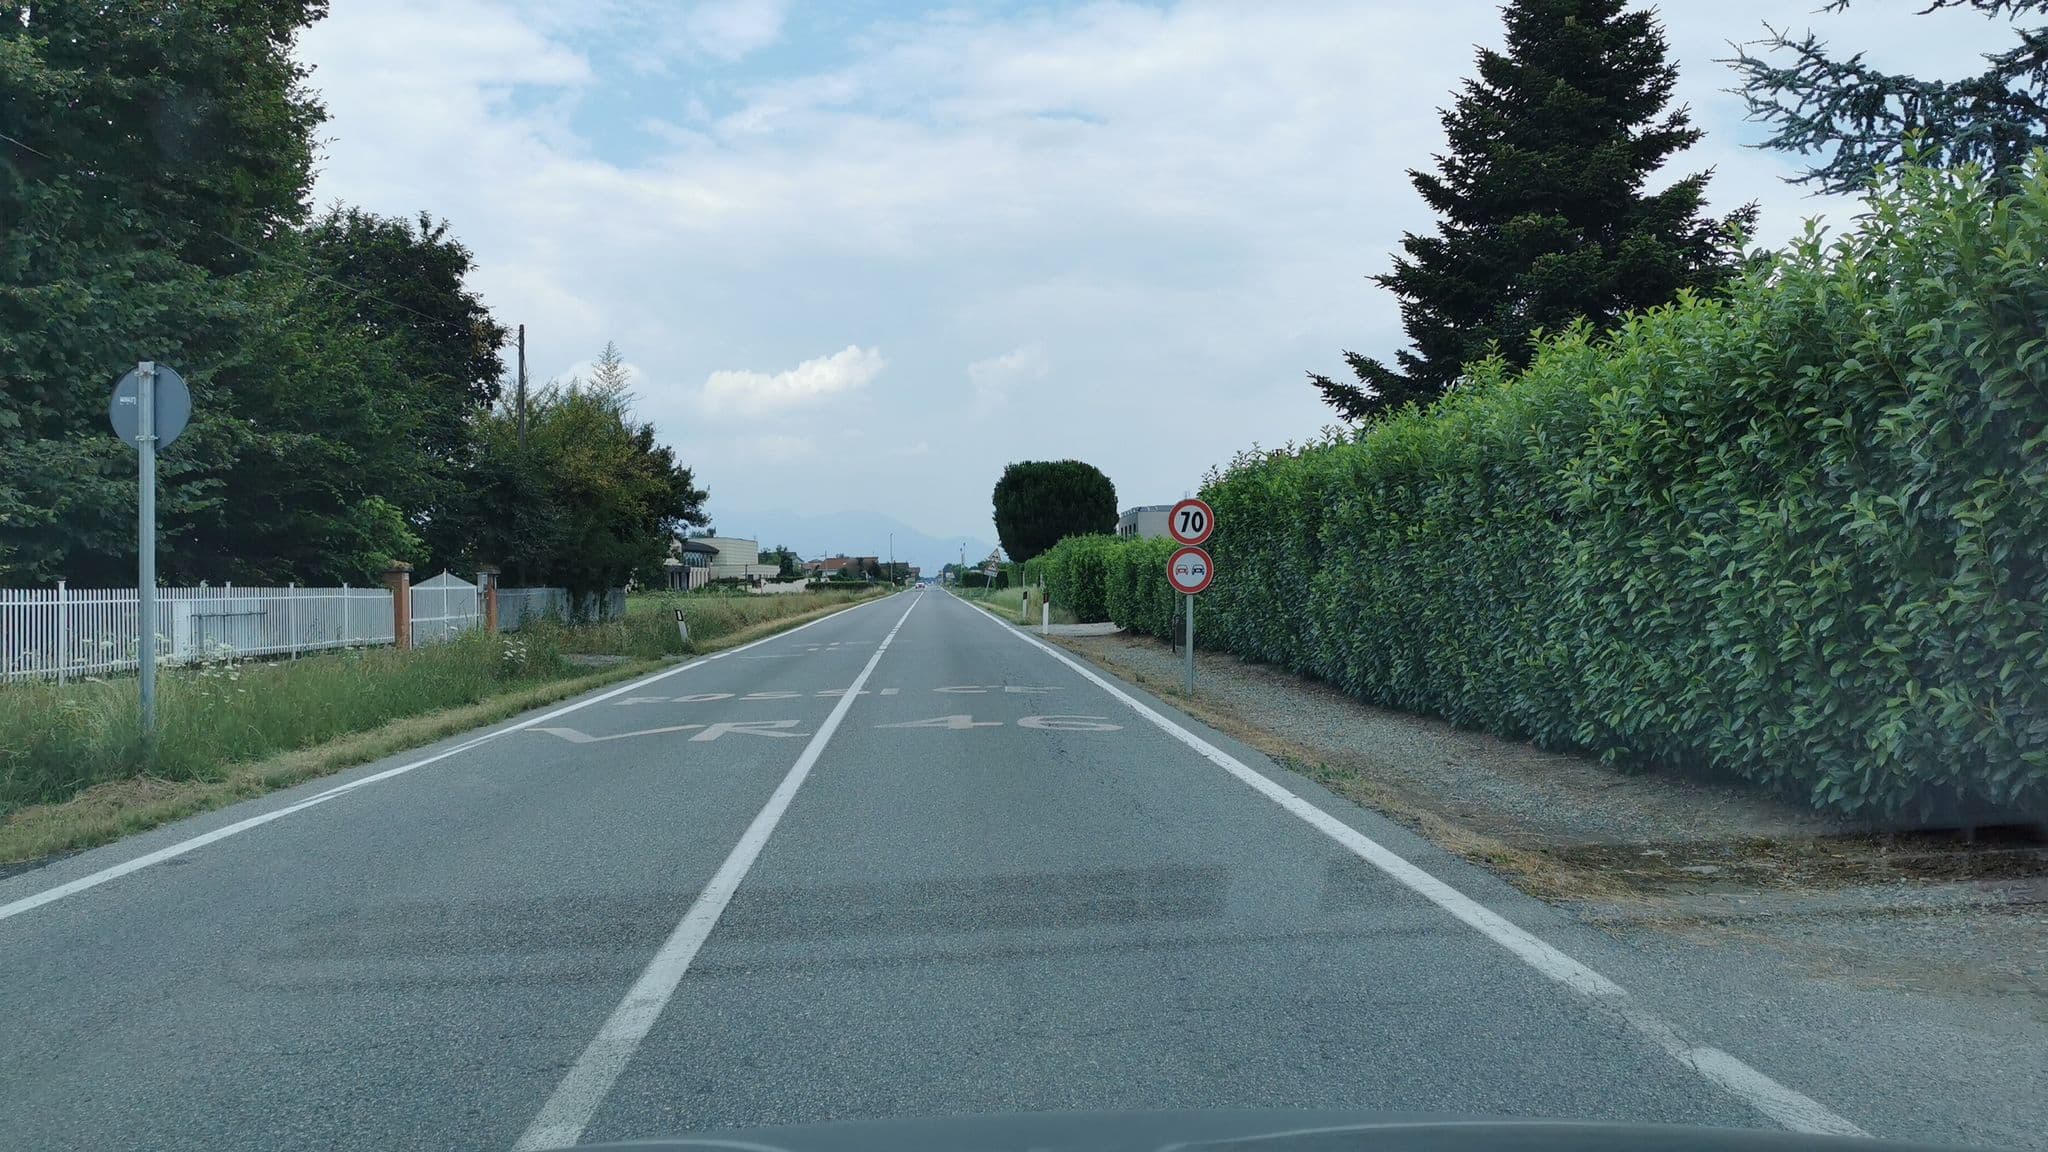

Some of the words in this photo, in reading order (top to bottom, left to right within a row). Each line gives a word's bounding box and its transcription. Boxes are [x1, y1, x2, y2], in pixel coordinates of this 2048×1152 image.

[1181, 511, 1204, 533] 70
[524, 719, 812, 744] VR
[874, 714, 1124, 731] 46
